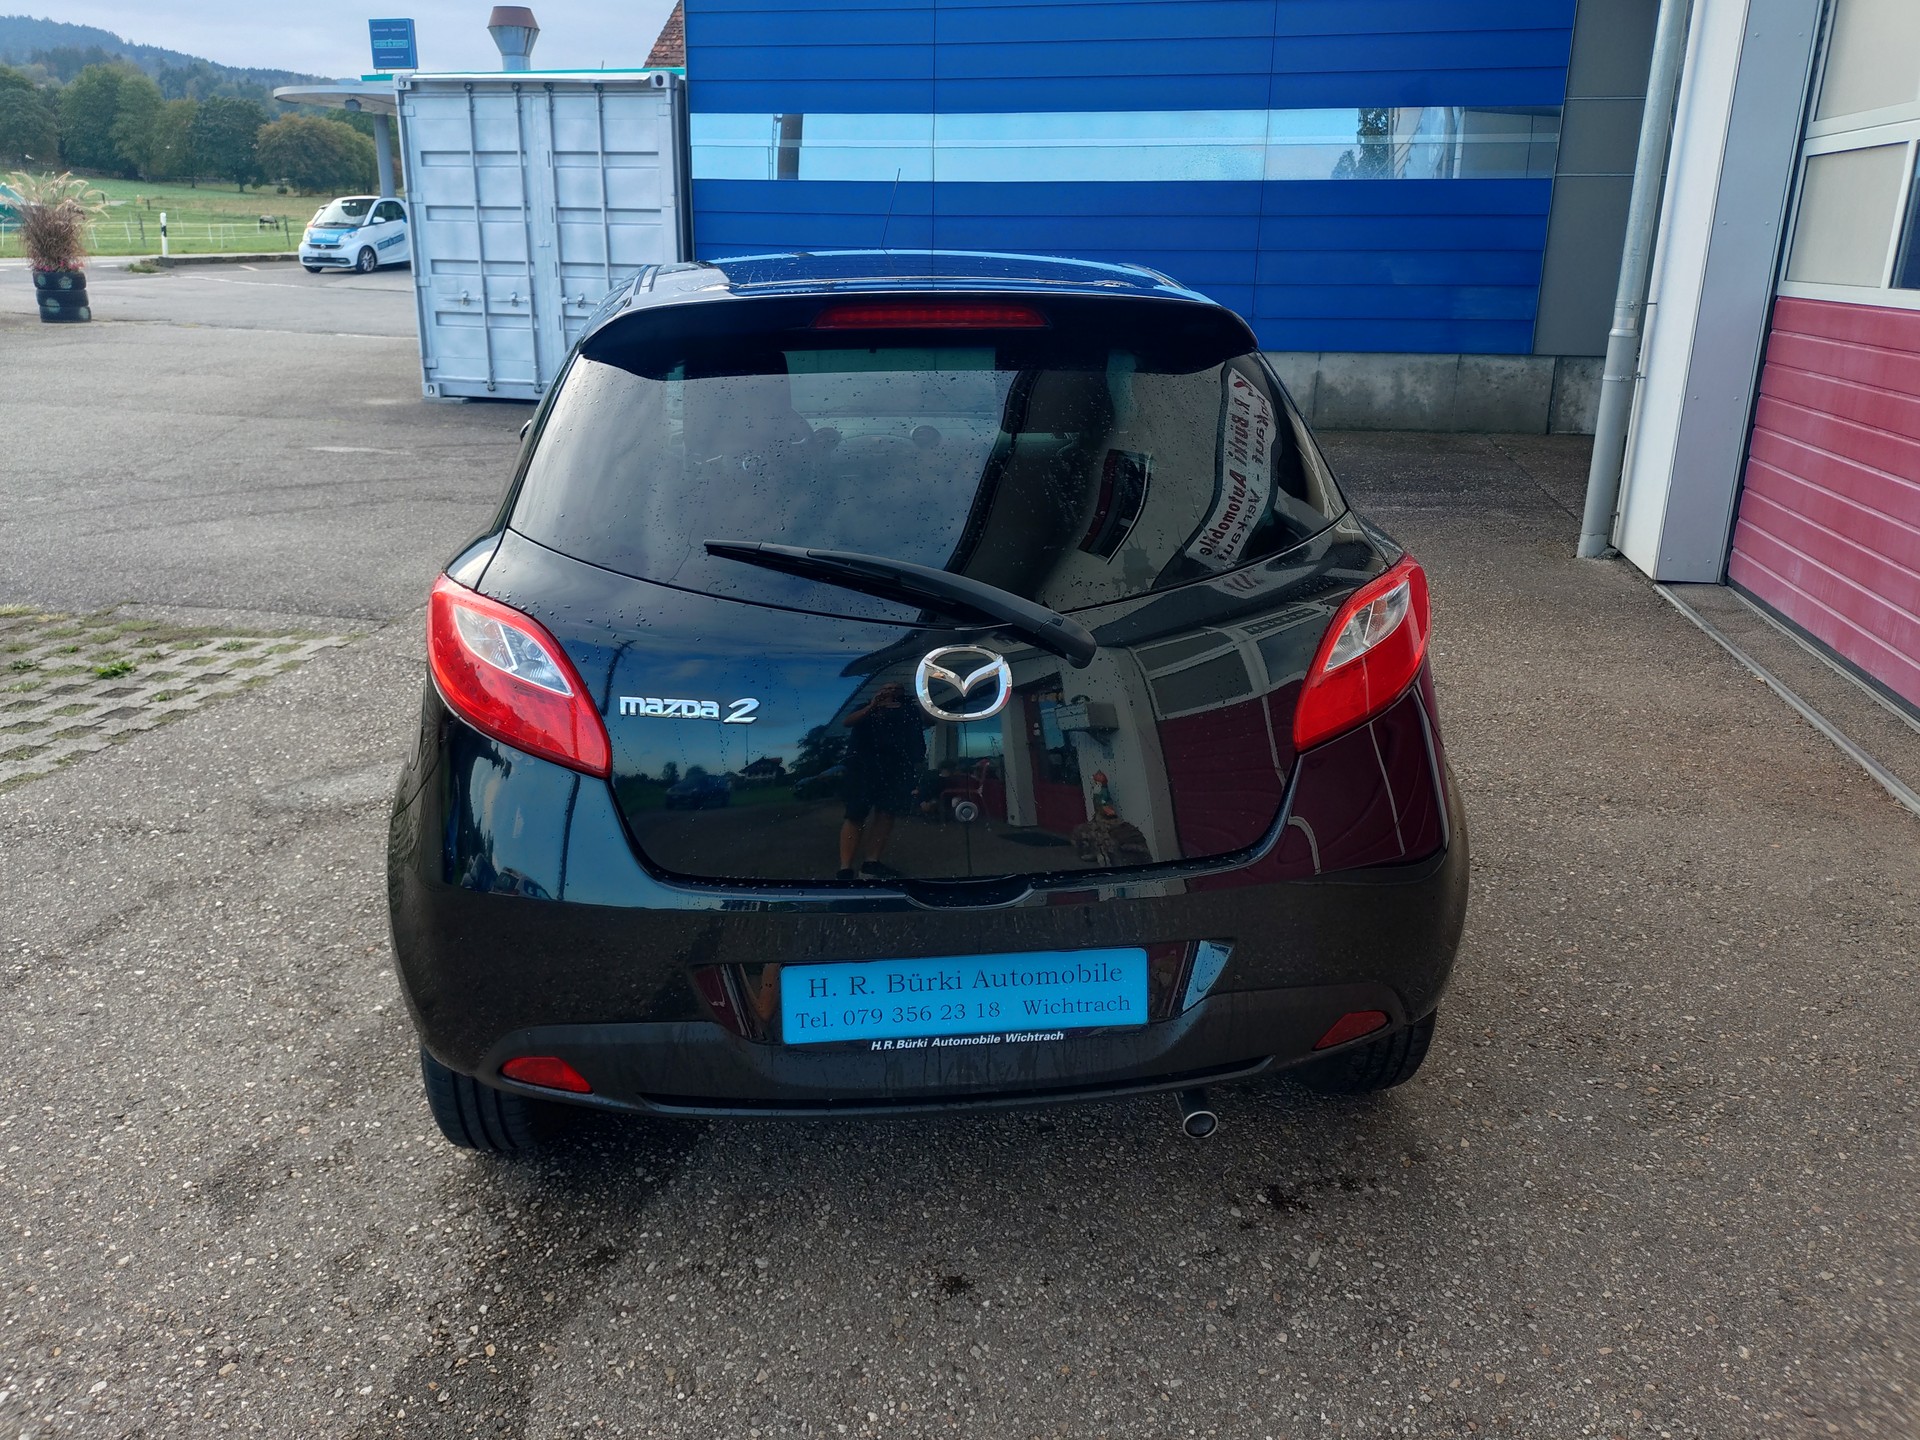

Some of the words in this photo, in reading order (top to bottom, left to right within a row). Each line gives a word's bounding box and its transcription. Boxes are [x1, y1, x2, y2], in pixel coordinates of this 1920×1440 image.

[723, 697, 760, 724] 2
[808, 978, 837, 998] H.
[849, 976, 875, 995] R.
[886, 970, 963, 994] Bürki
[972, 963, 1122, 989] Automobile
[795, 1011, 834, 1029] Tel.
[843, 1008, 883, 1026] 079
[892, 1005, 932, 1023] 356
[940, 1003, 966, 1020] 23
[977, 1001, 1001, 1018] 18
[1023, 995, 1131, 1016] Wichtrach
[931, 1034, 1001, 1048] Automobile
[1005, 1031, 1065, 1044] Wichtrach
